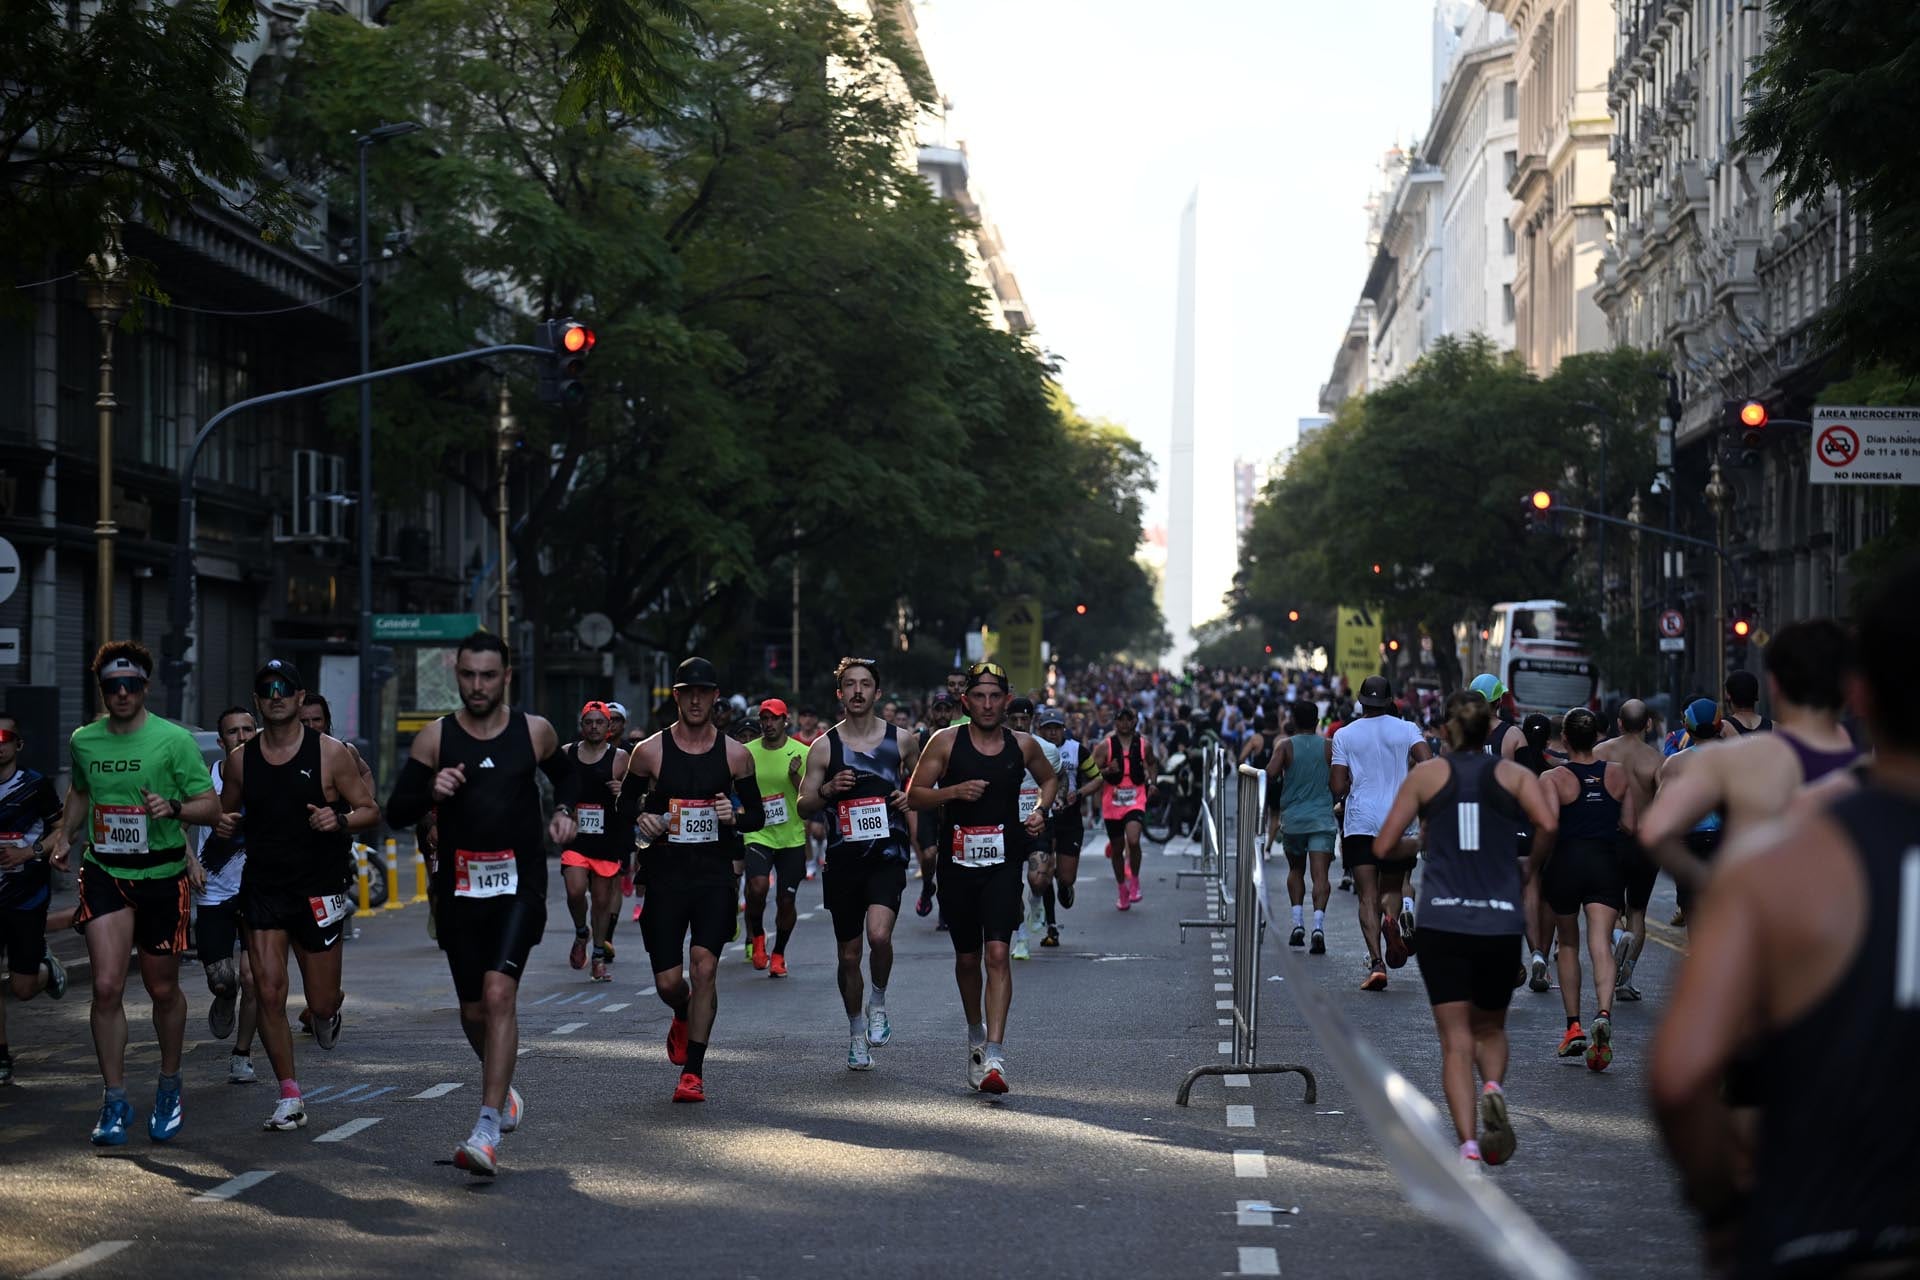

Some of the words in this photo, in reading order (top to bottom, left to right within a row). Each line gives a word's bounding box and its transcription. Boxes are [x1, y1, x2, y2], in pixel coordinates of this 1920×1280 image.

[1819, 409, 1846, 418] ÁREA
[1850, 410, 1920, 418] MICROCENTR
[1866, 435, 1886, 444] Días
[1864, 448, 1875, 456] de
[1879, 448, 1887, 456] 11
[1900, 448, 1909, 456] 16
[1834, 471, 1848, 480] NO
[1852, 471, 1901, 480] INGRESAR
[376, 618, 420, 628] Catedral
[90, 760, 141, 773] NEOS
[765, 807, 784, 819] 2348
[119, 817, 139, 825] FRANCO
[580, 817, 600, 827] 5773
[686, 819, 713, 833] 5293
[857, 816, 882, 831] 1868
[111, 828, 140, 843] 4020
[971, 846, 998, 859] 1750
[478, 872, 509, 888] 1478
